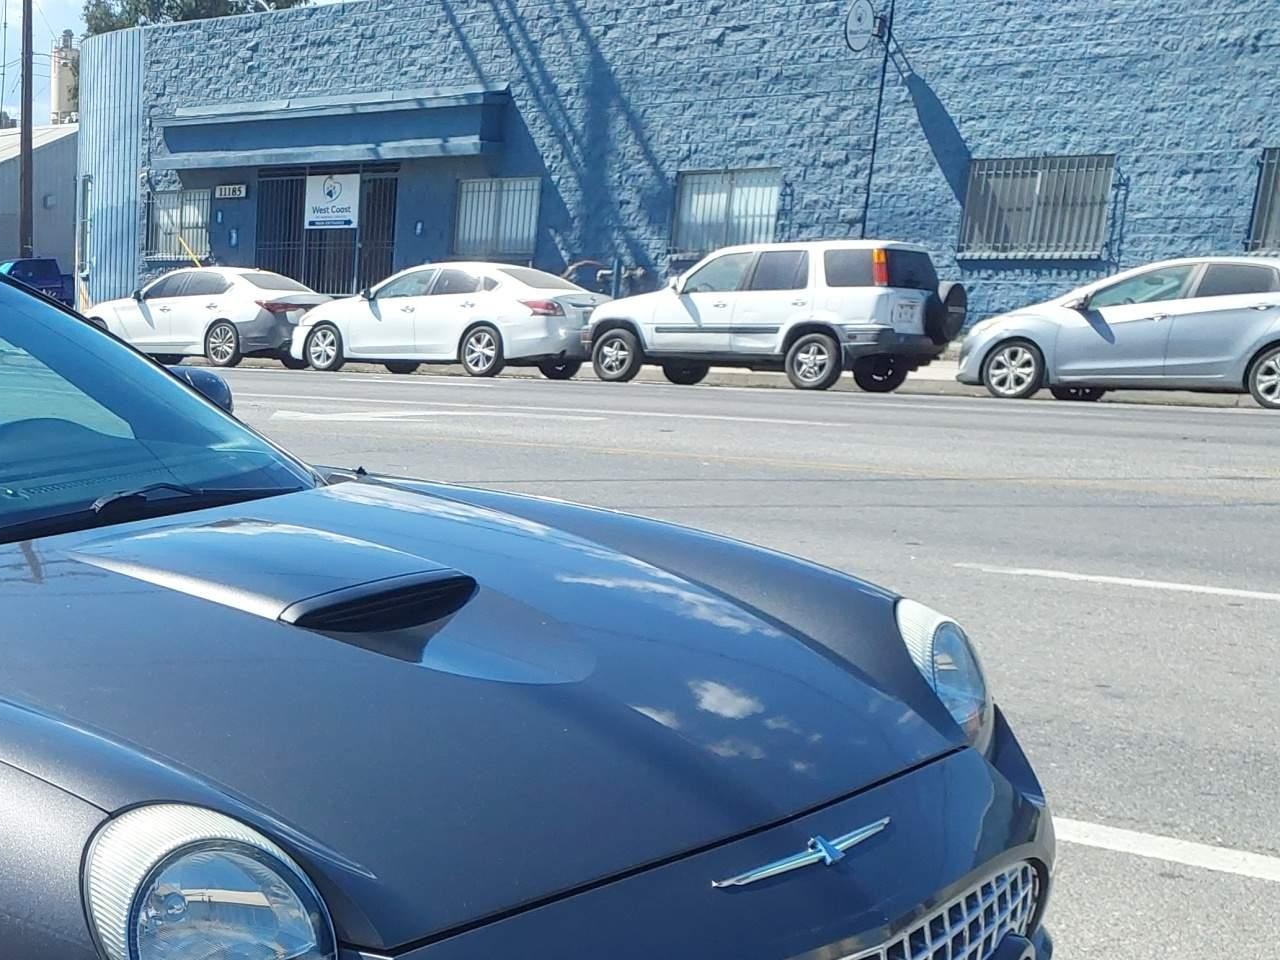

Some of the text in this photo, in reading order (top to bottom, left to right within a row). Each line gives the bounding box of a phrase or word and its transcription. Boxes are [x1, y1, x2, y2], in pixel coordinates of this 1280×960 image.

[218, 187, 242, 197] 11185
[312, 205, 351, 214] West Coast
